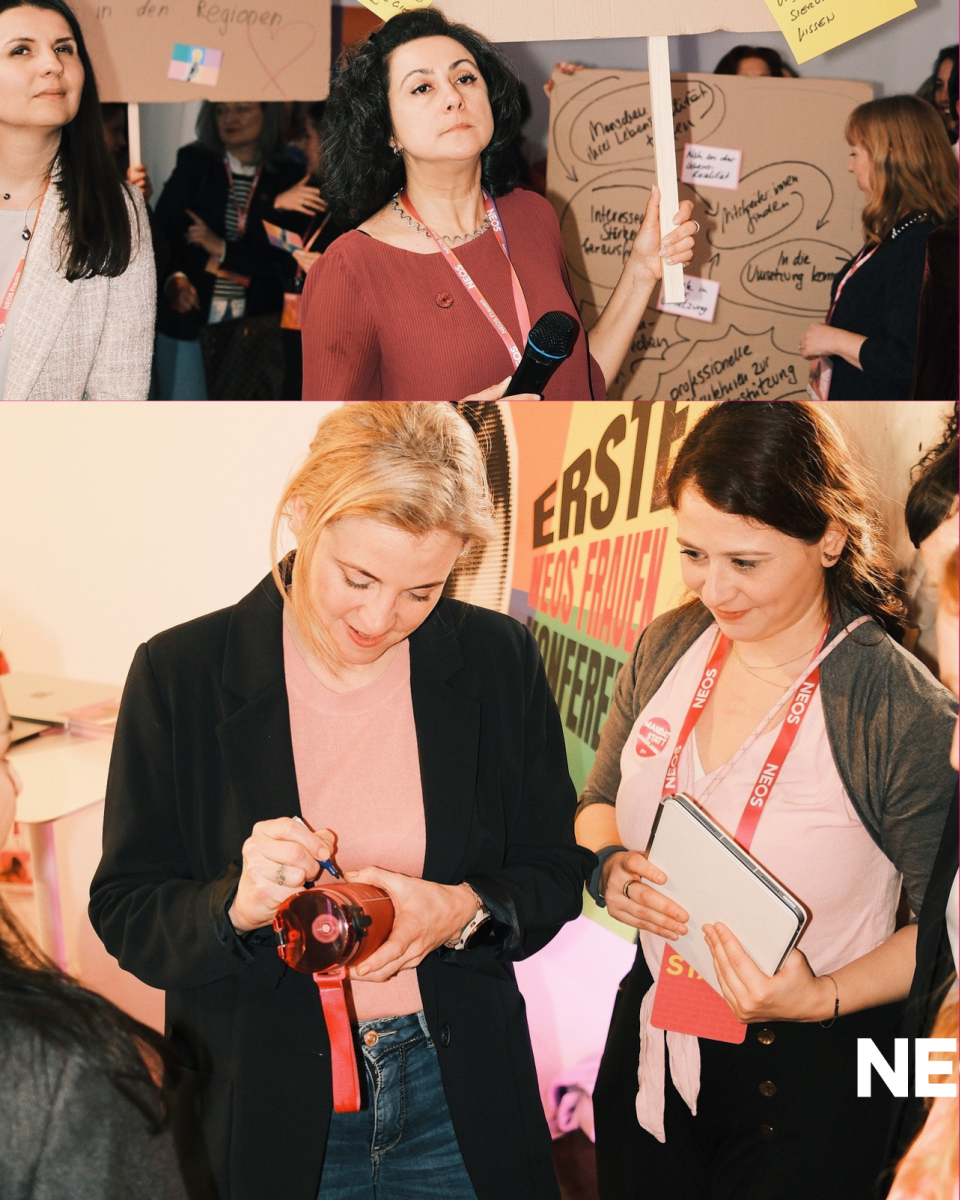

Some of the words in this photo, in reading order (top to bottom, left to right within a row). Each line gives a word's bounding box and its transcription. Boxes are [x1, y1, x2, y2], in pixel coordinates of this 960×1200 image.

[136, 0, 169, 16] den
[527, 545, 579, 627] NEOS
[575, 526, 669, 655] FRAUEN
[692, 667, 717, 709] NEOS
[787, 681, 816, 725] NEOS
[643, 720, 670, 741] MANDAT
[646, 732, 667, 747] STATT
[665, 744, 682, 790] NEOS
[750, 762, 779, 808] NEOS
